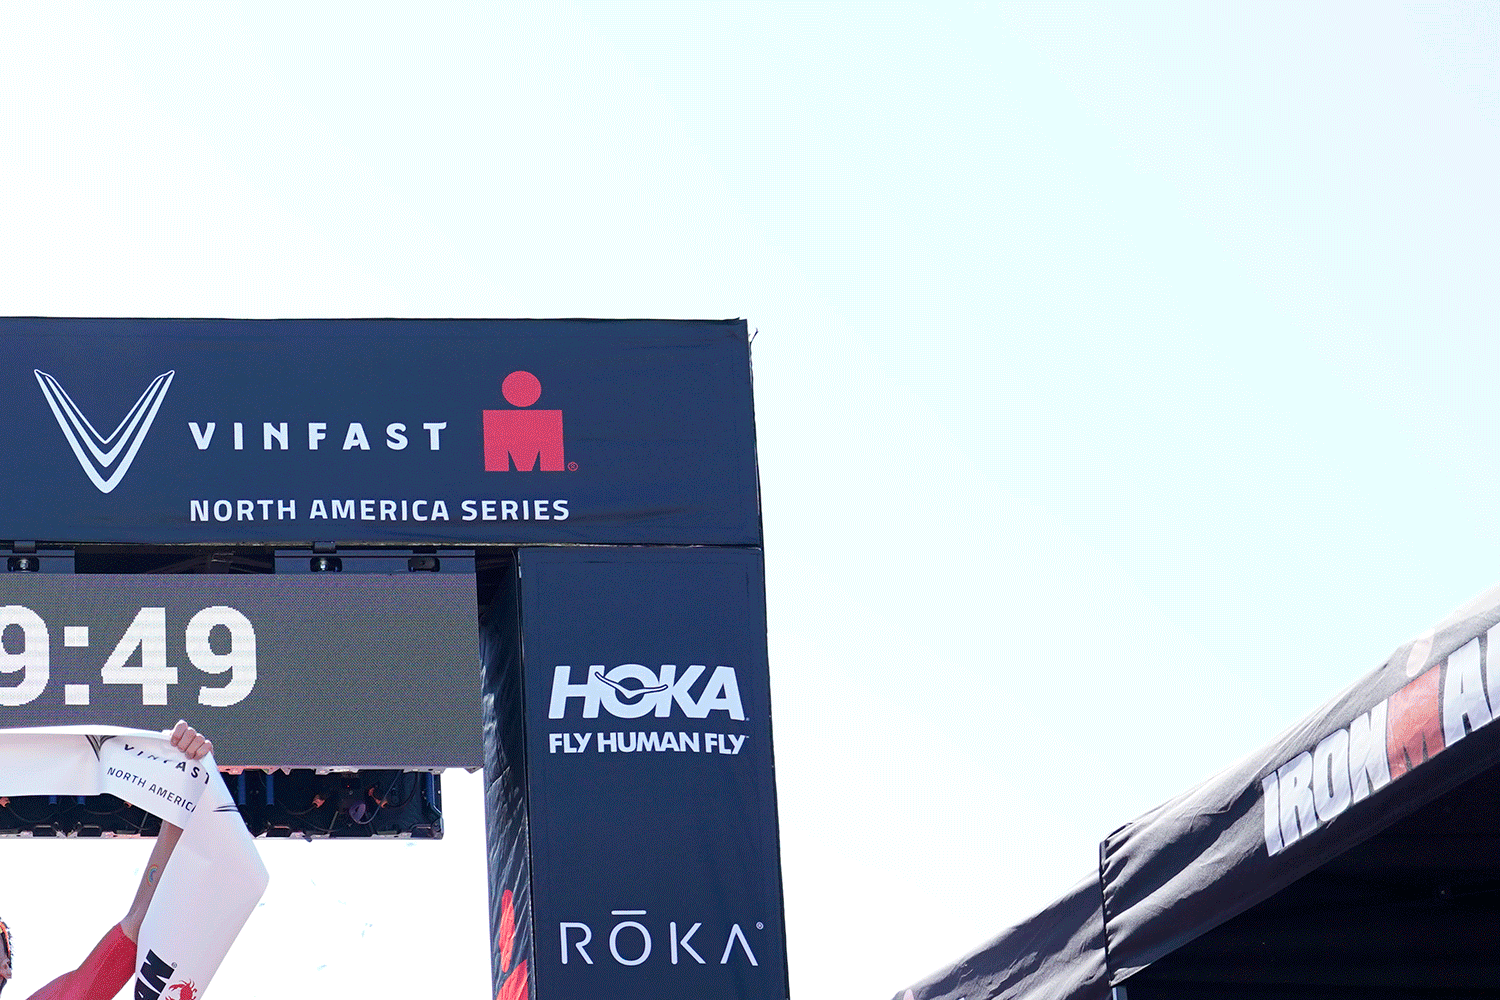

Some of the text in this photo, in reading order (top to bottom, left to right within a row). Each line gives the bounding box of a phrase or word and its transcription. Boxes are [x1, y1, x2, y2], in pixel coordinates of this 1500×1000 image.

[189, 421, 447, 451] VINFAST
[190, 499, 570, 522] NORTH AMERICA SERIES
[547, 663, 745, 721] HOKA
[549, 731, 746, 755] FLY HUMAN FLY
[107, 767, 147, 788] NORTH
